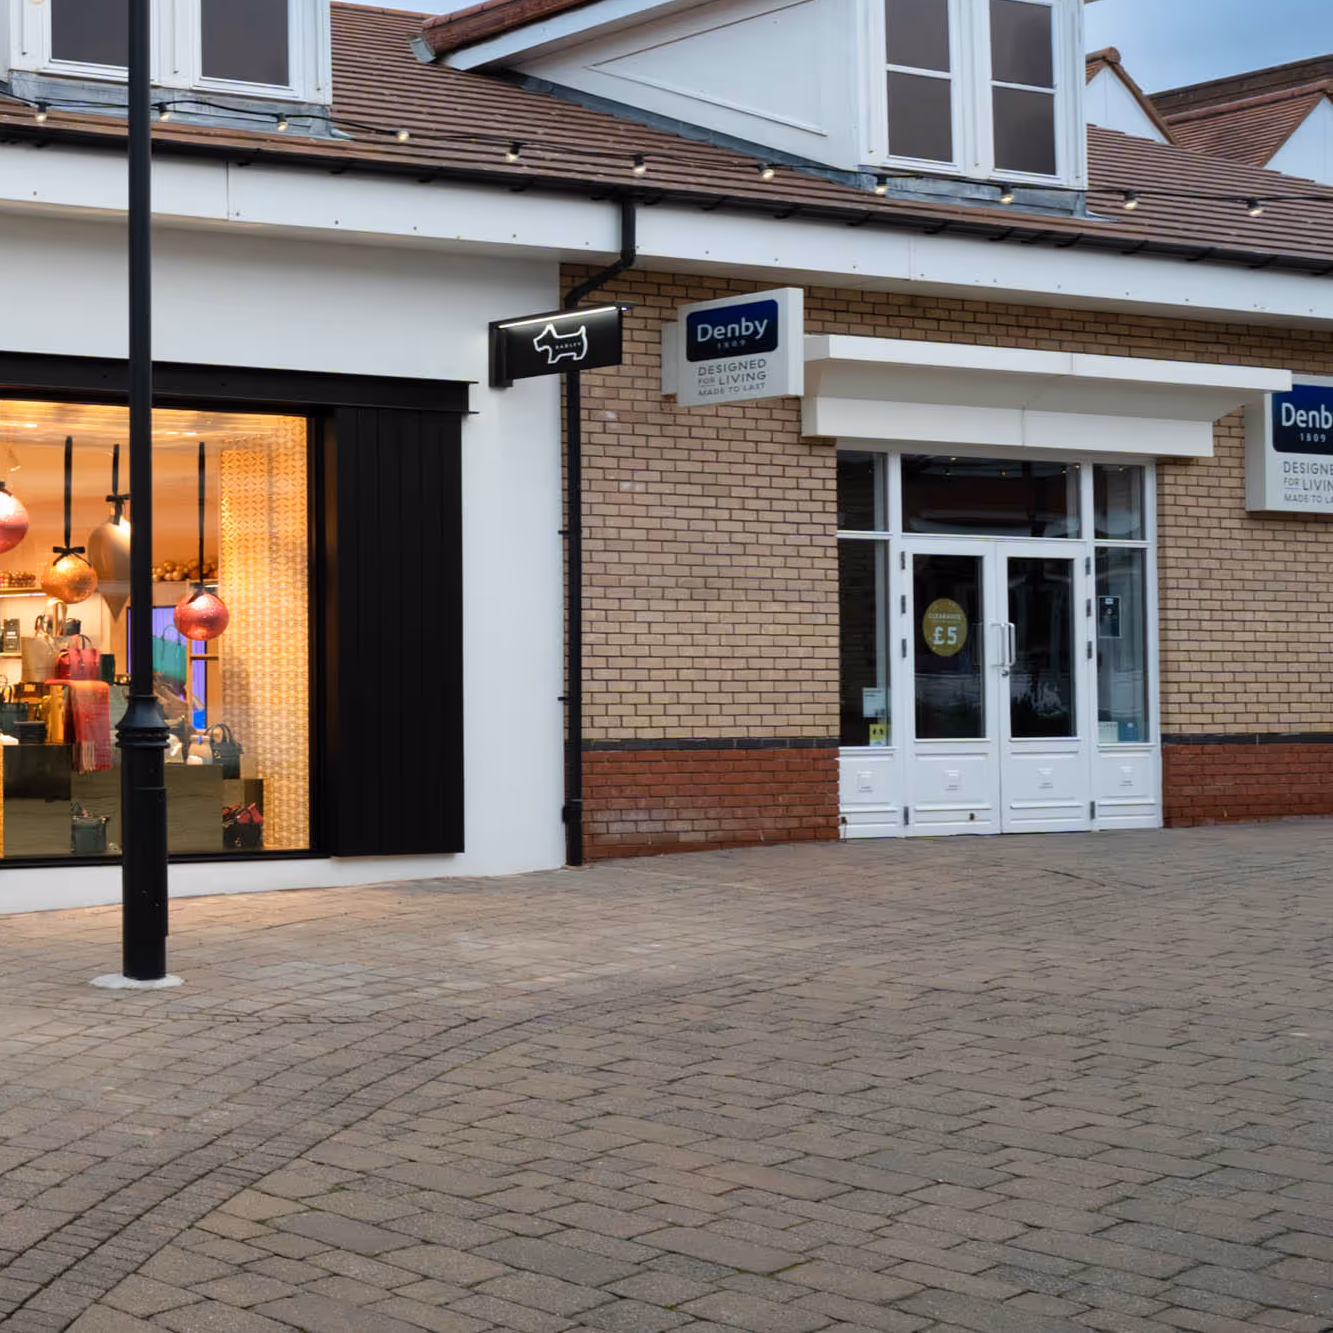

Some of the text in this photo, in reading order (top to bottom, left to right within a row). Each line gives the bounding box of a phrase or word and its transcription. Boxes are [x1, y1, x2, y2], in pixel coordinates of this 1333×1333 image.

[697, 316, 769, 342] Denby
[698, 358, 767, 376] DESIGNED
[698, 371, 767, 385] FOR LIVING
[698, 382, 766, 397] MADE TO LAST
[1281, 402, 1333, 429] Denb
[1300, 433, 1326, 442] 1809
[1283, 461, 1333, 475] DESIGNE
[1284, 477, 1333, 492] FOR LIVIN
[1284, 493, 1308, 503] MADE
[1311, 494, 1322, 504] TO
[933, 626, 958, 645] £5
